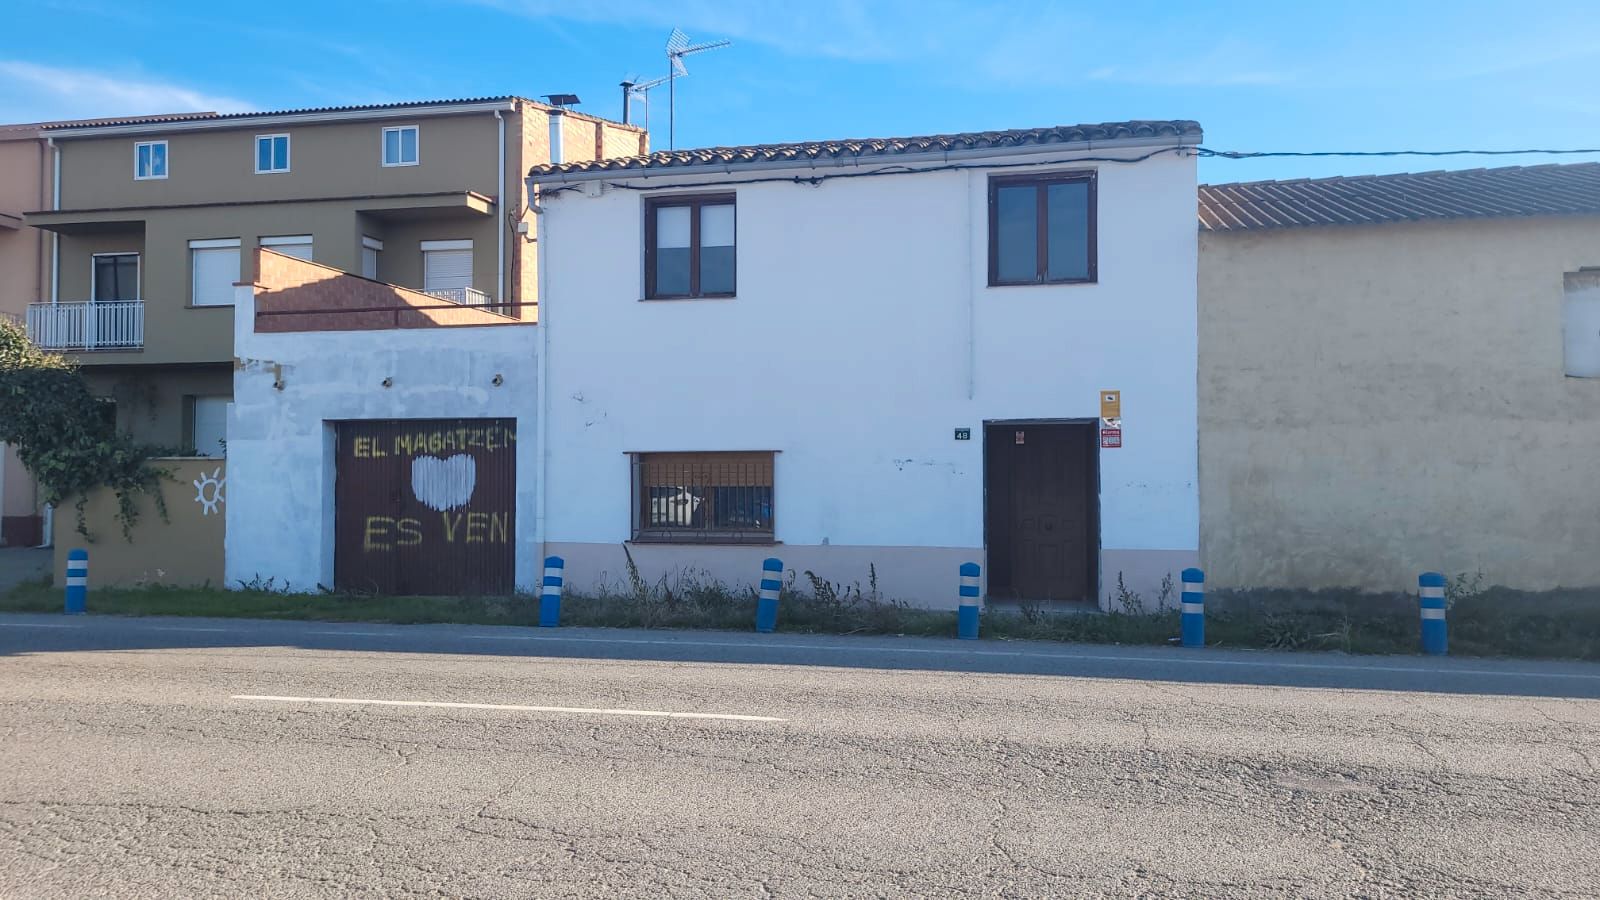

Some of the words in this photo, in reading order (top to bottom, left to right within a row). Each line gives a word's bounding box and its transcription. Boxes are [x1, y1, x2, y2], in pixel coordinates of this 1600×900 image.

[353, 435, 387, 458] EL
[363, 516, 423, 552] ES
[442, 511, 508, 544] VEN
